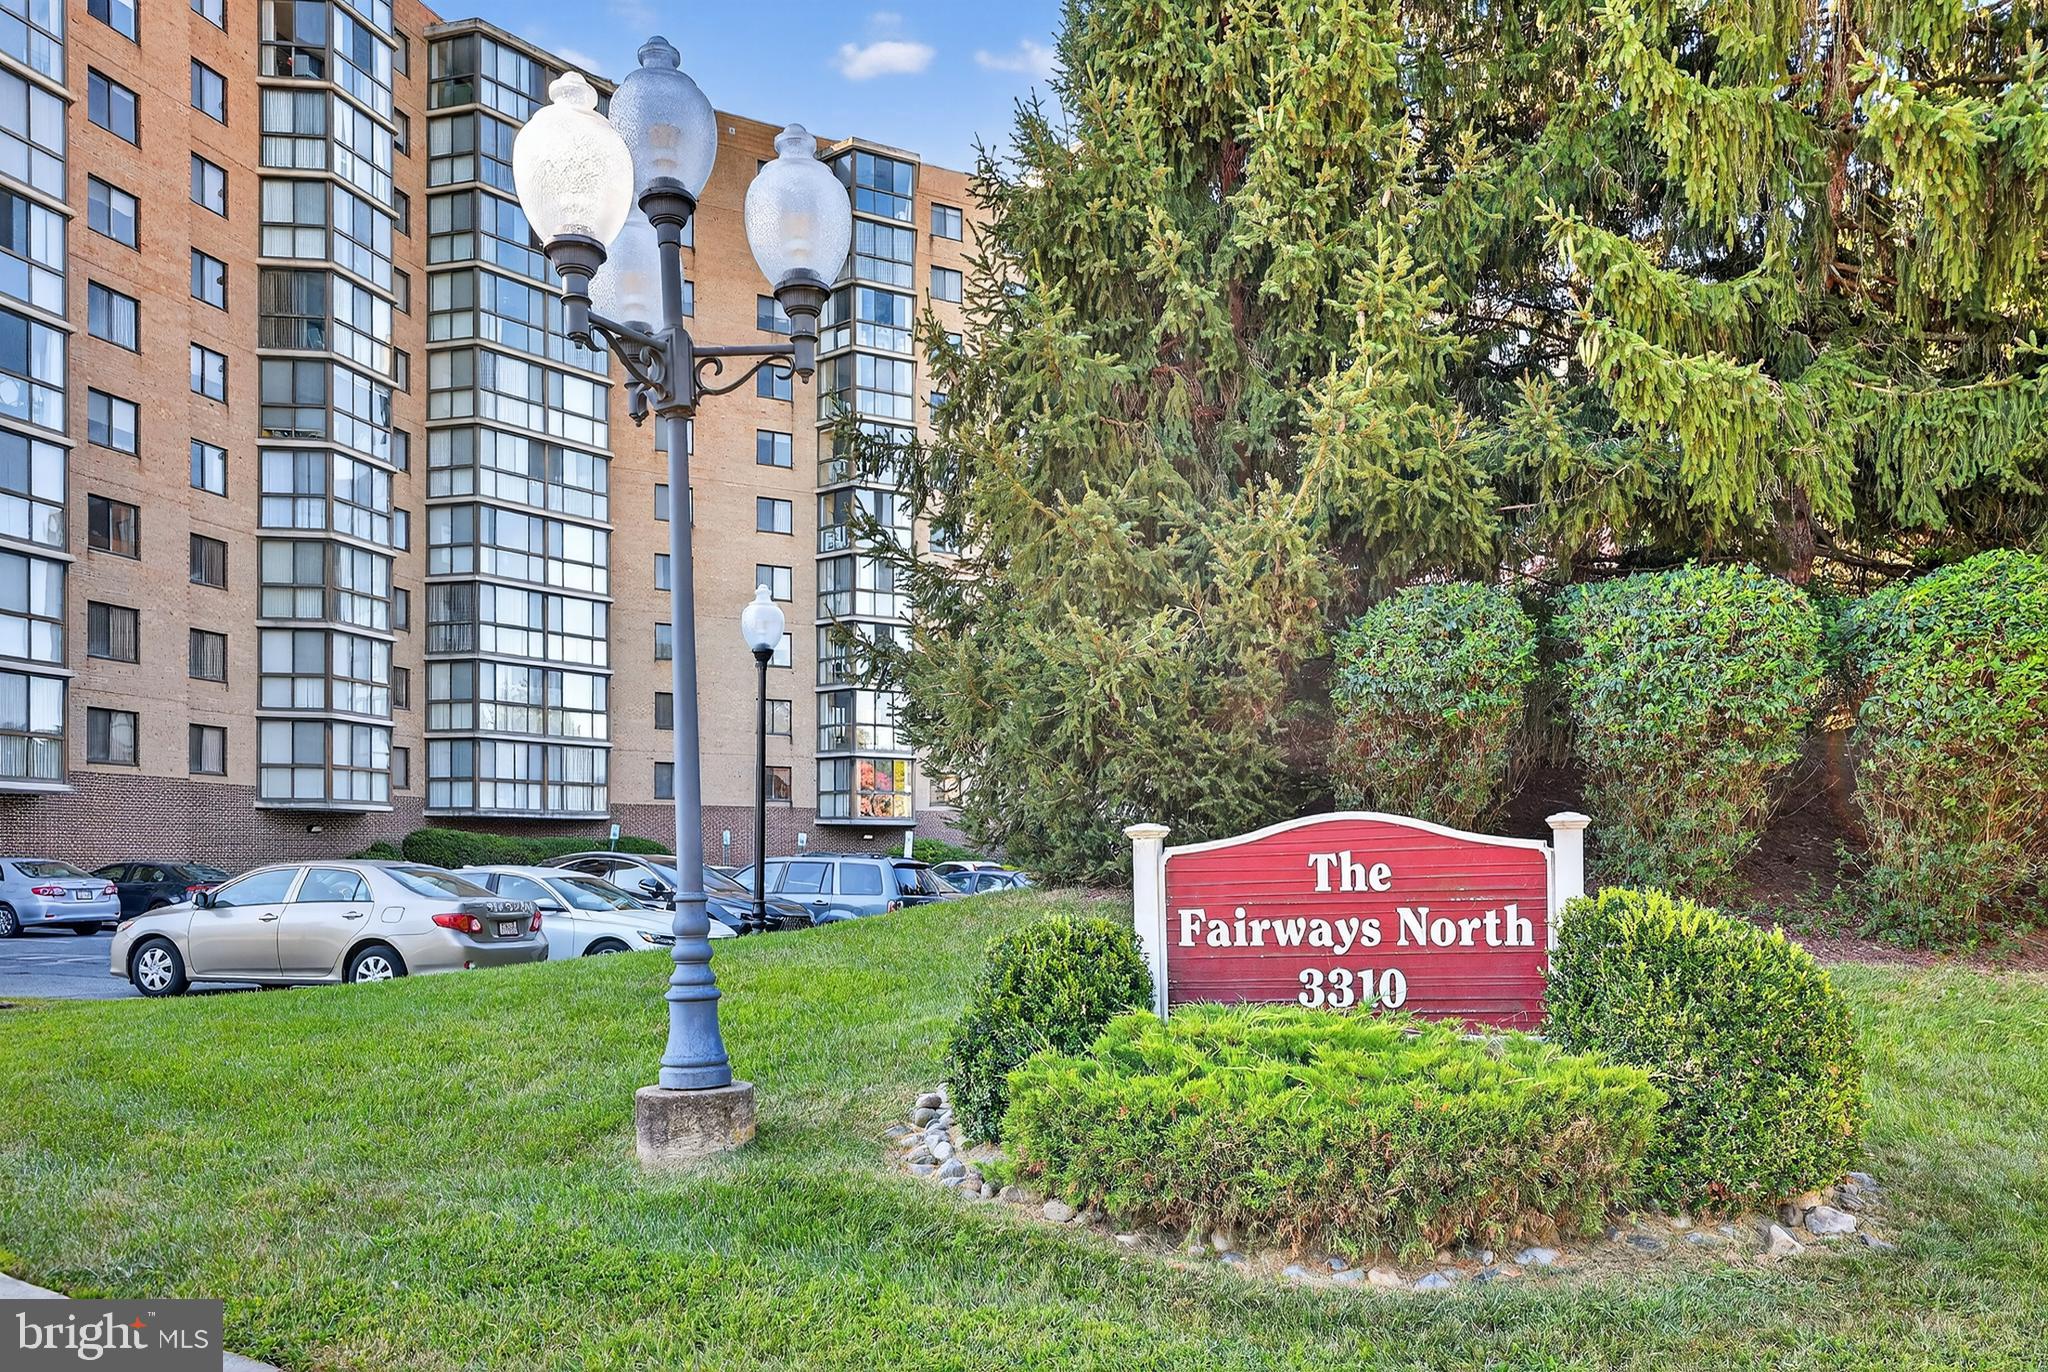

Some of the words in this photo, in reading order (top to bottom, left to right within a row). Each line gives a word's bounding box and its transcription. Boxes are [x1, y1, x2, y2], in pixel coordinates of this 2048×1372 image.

[1308, 851, 1392, 892] The
[1177, 907, 1382, 955] Fairways
[1397, 904, 1535, 947] North
[1299, 968, 1407, 1009] 3310
